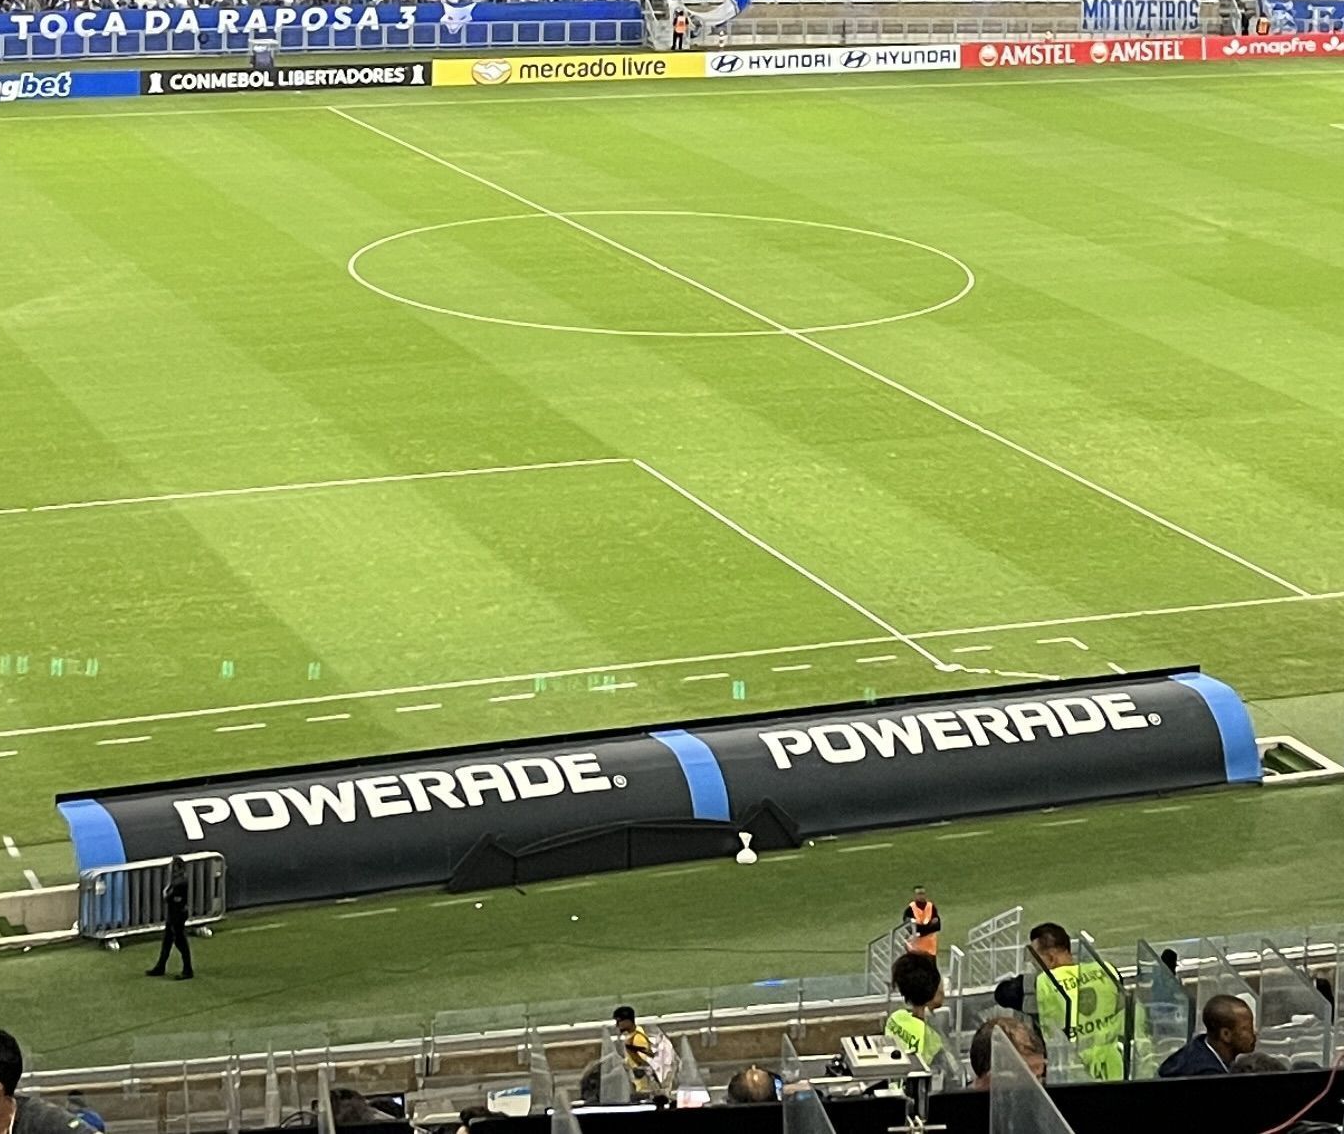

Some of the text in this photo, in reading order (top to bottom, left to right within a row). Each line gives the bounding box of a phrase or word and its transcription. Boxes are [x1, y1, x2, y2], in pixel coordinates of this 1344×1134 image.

[10, 6, 417, 40] TOCA DA RAPOSA 3
[1000, 40, 1184, 66] AMSTEL AMSTEL
[1249, 36, 1317, 56] mapfre
[519, 58, 666, 79] mercado livre
[749, 50, 957, 69] HYUNDAI HYUNDAI
[170, 66, 406, 91] CONMEBOL LIBERTADORES
[759, 692, 1149, 769] POWERADE
[173, 752, 612, 840] POWERADE
